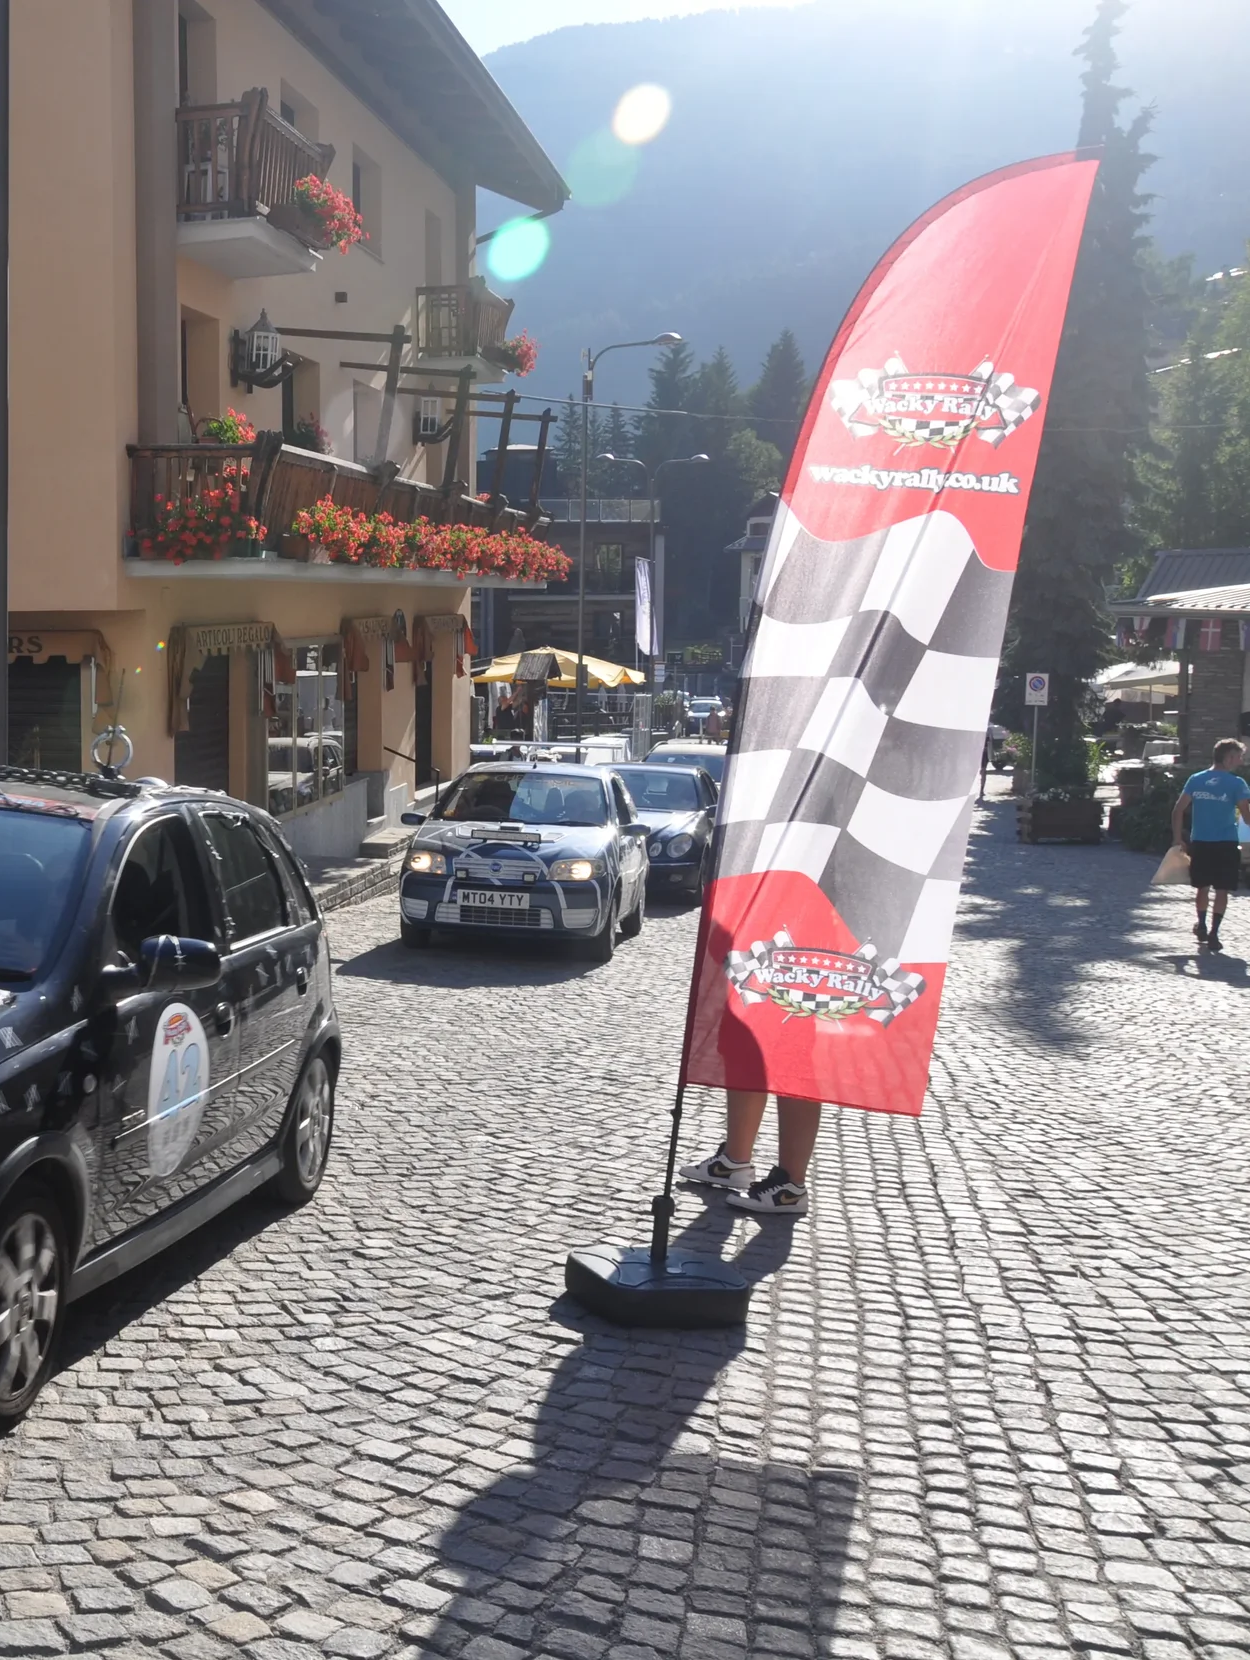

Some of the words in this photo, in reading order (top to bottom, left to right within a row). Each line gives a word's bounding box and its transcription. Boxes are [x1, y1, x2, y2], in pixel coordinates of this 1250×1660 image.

[868, 395, 938, 415] Wacky
[941, 397, 996, 418] Rally
[808, 464, 1019, 494] wackyrally.co.uk
[196, 628, 235, 648] ARTICOLI
[237, 626, 270, 644] REGALO
[462, 891, 495, 905] MT04
[499, 894, 524, 907] YTY
[753, 966, 827, 988] Wacky
[827, 972, 884, 1000] Rally
